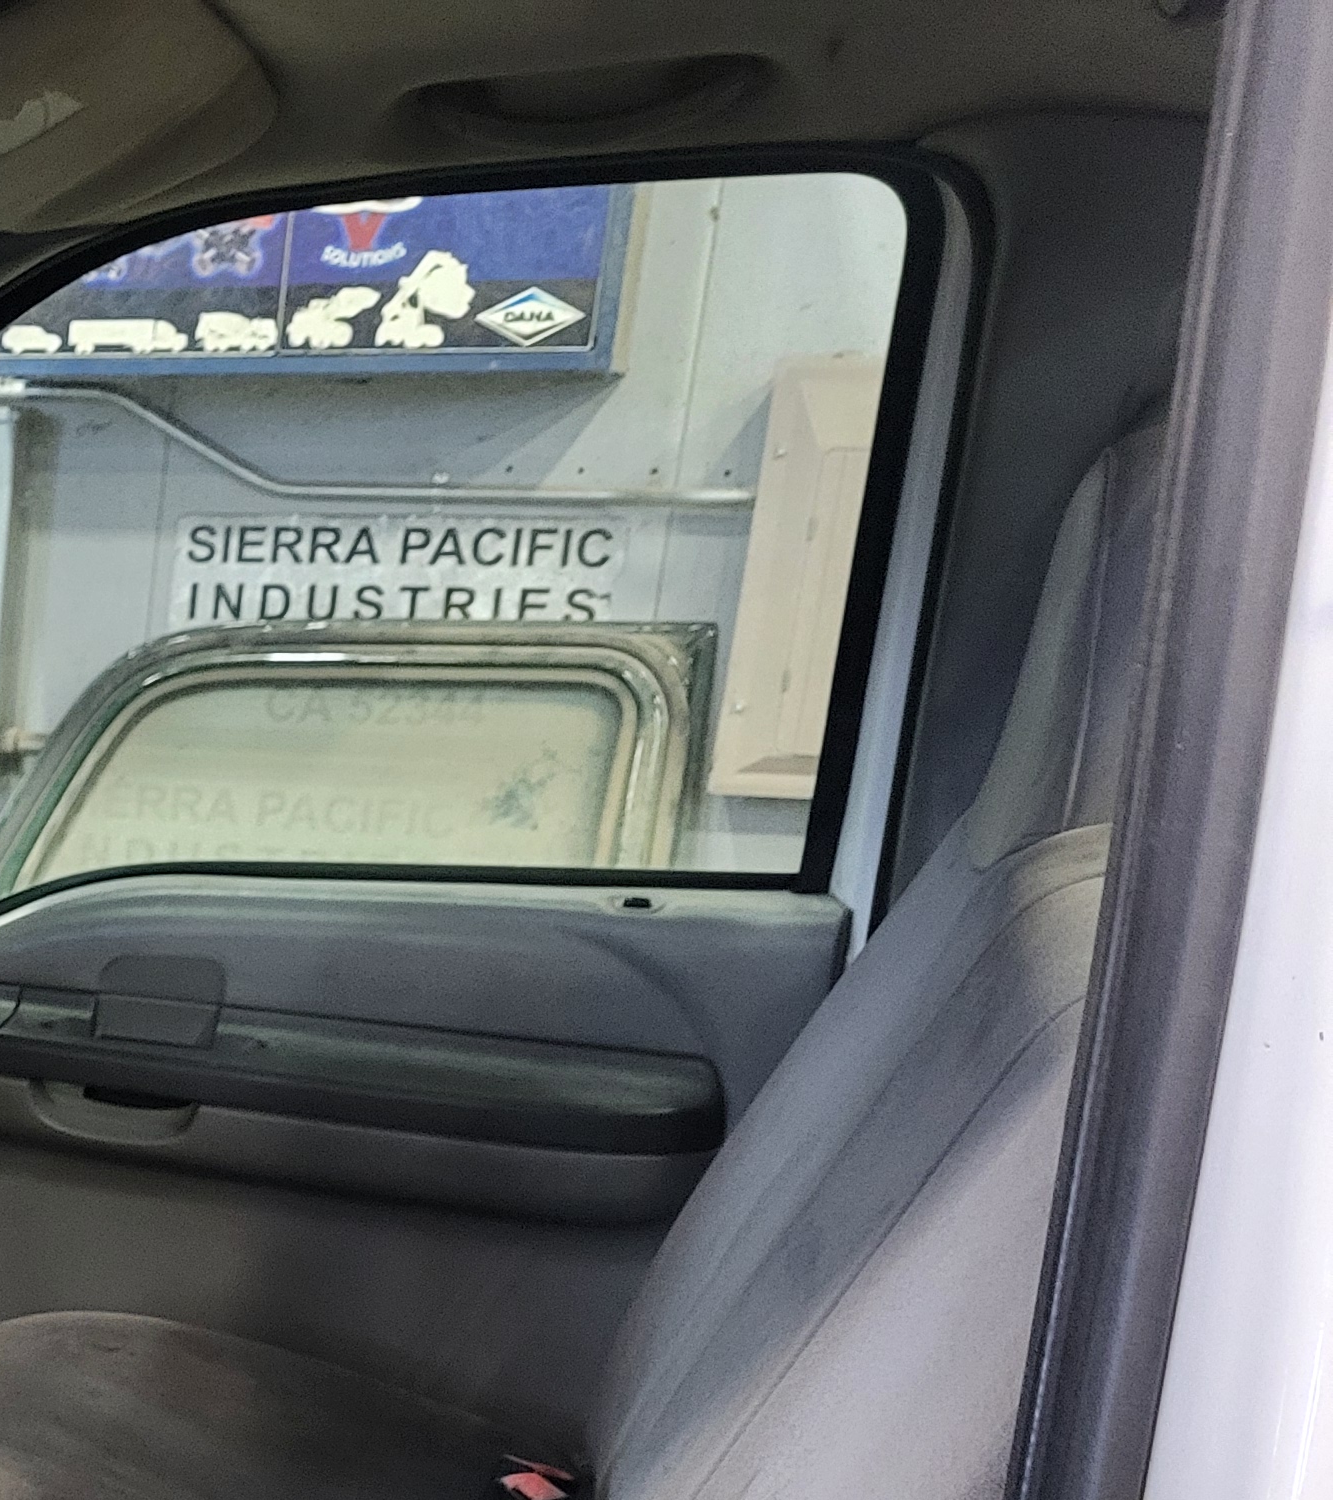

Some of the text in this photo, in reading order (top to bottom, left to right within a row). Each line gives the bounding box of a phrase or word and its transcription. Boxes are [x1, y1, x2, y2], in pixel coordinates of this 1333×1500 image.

[321, 242, 408, 268] SOLUTIONS
[503, 310, 556, 324] DANA
[187, 524, 615, 568] SIERRA PACIFIC
[188, 582, 598, 622] INDUSTRIES
